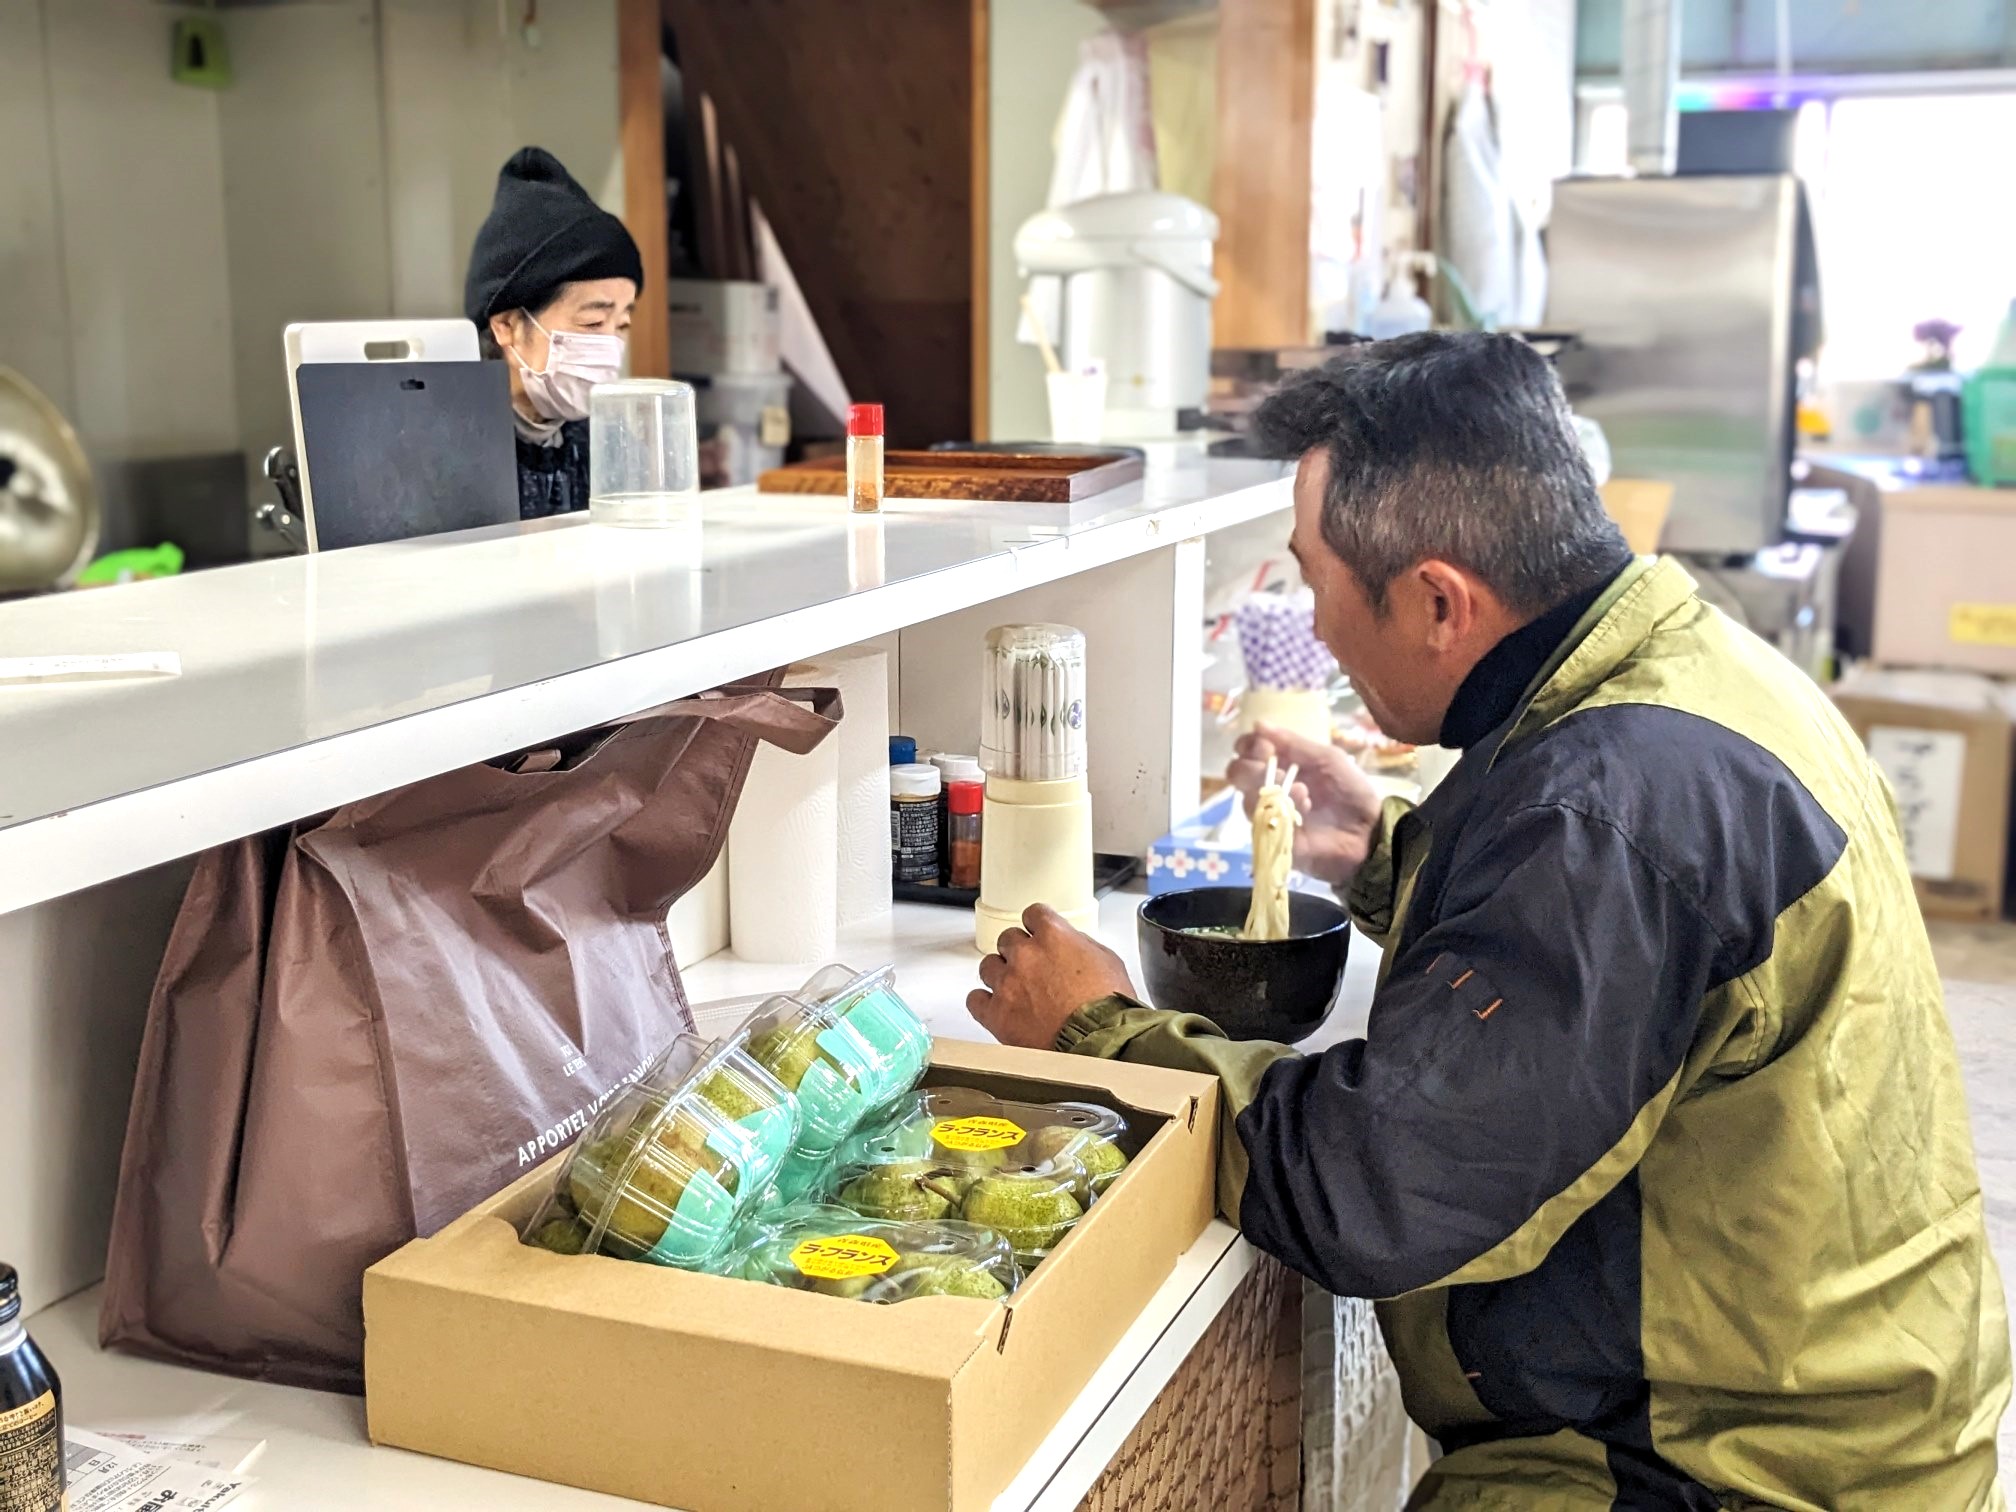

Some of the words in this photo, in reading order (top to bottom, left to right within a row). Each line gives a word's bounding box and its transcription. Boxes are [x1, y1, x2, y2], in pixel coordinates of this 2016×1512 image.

[517, 1108, 589, 1167] APPORTEZ
[937, 1123, 1020, 1141] ラ・フランス
[799, 1243, 892, 1266] ラ・フランス
